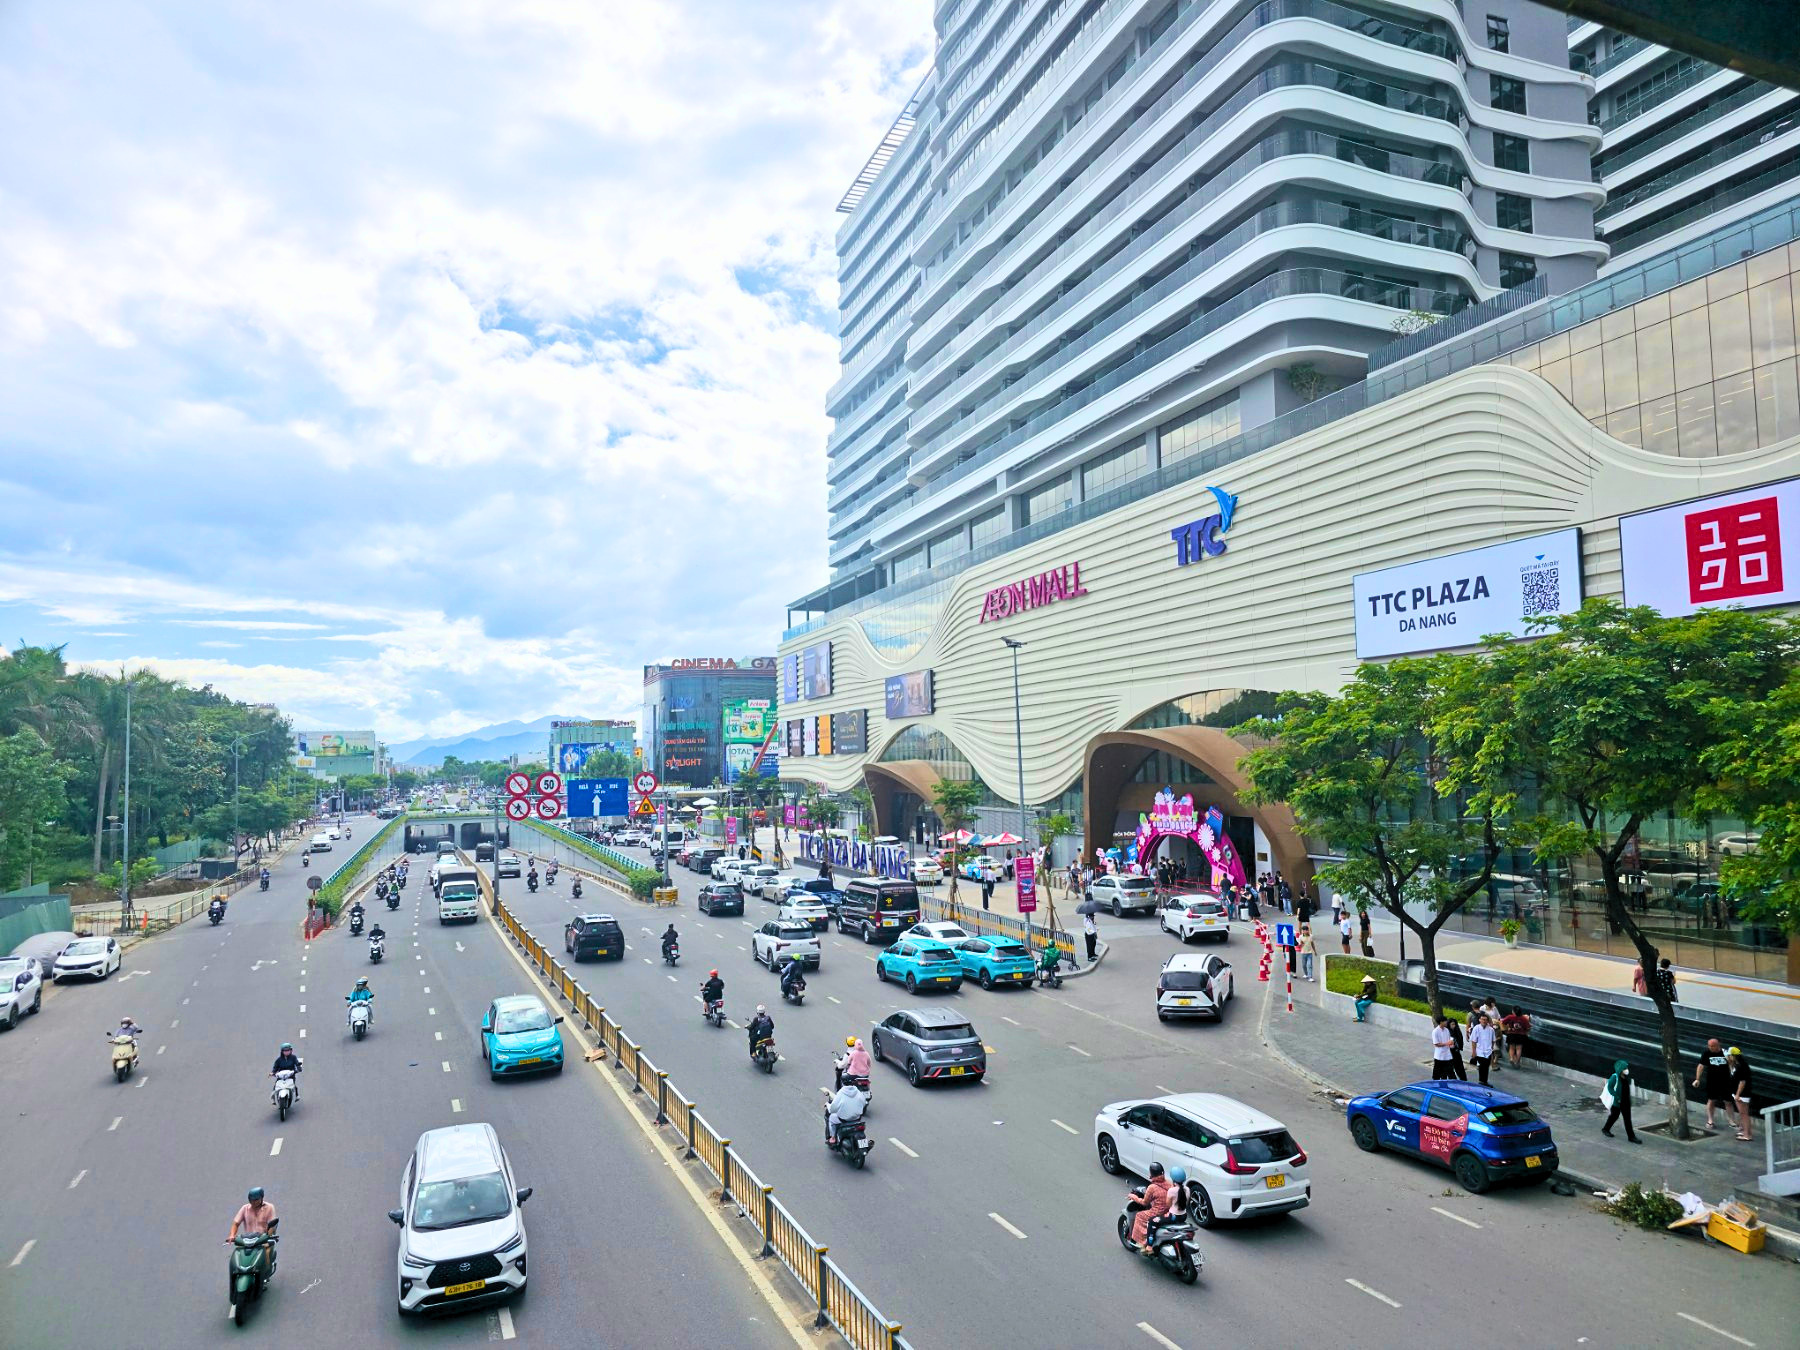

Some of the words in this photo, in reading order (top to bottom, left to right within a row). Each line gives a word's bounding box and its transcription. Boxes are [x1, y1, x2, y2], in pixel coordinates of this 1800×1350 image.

[1171, 513, 1227, 566] TTC
[1028, 561, 1088, 608] MALL
[1368, 590, 1407, 617] TTC
[1412, 575, 1490, 611] PLAZA
[1400, 618, 1416, 633] DA
[1419, 611, 1457, 630] NANG
[671, 657, 737, 670] CINEMA
[543, 779, 554, 790] 50
[852, 841, 868, 872] DA
